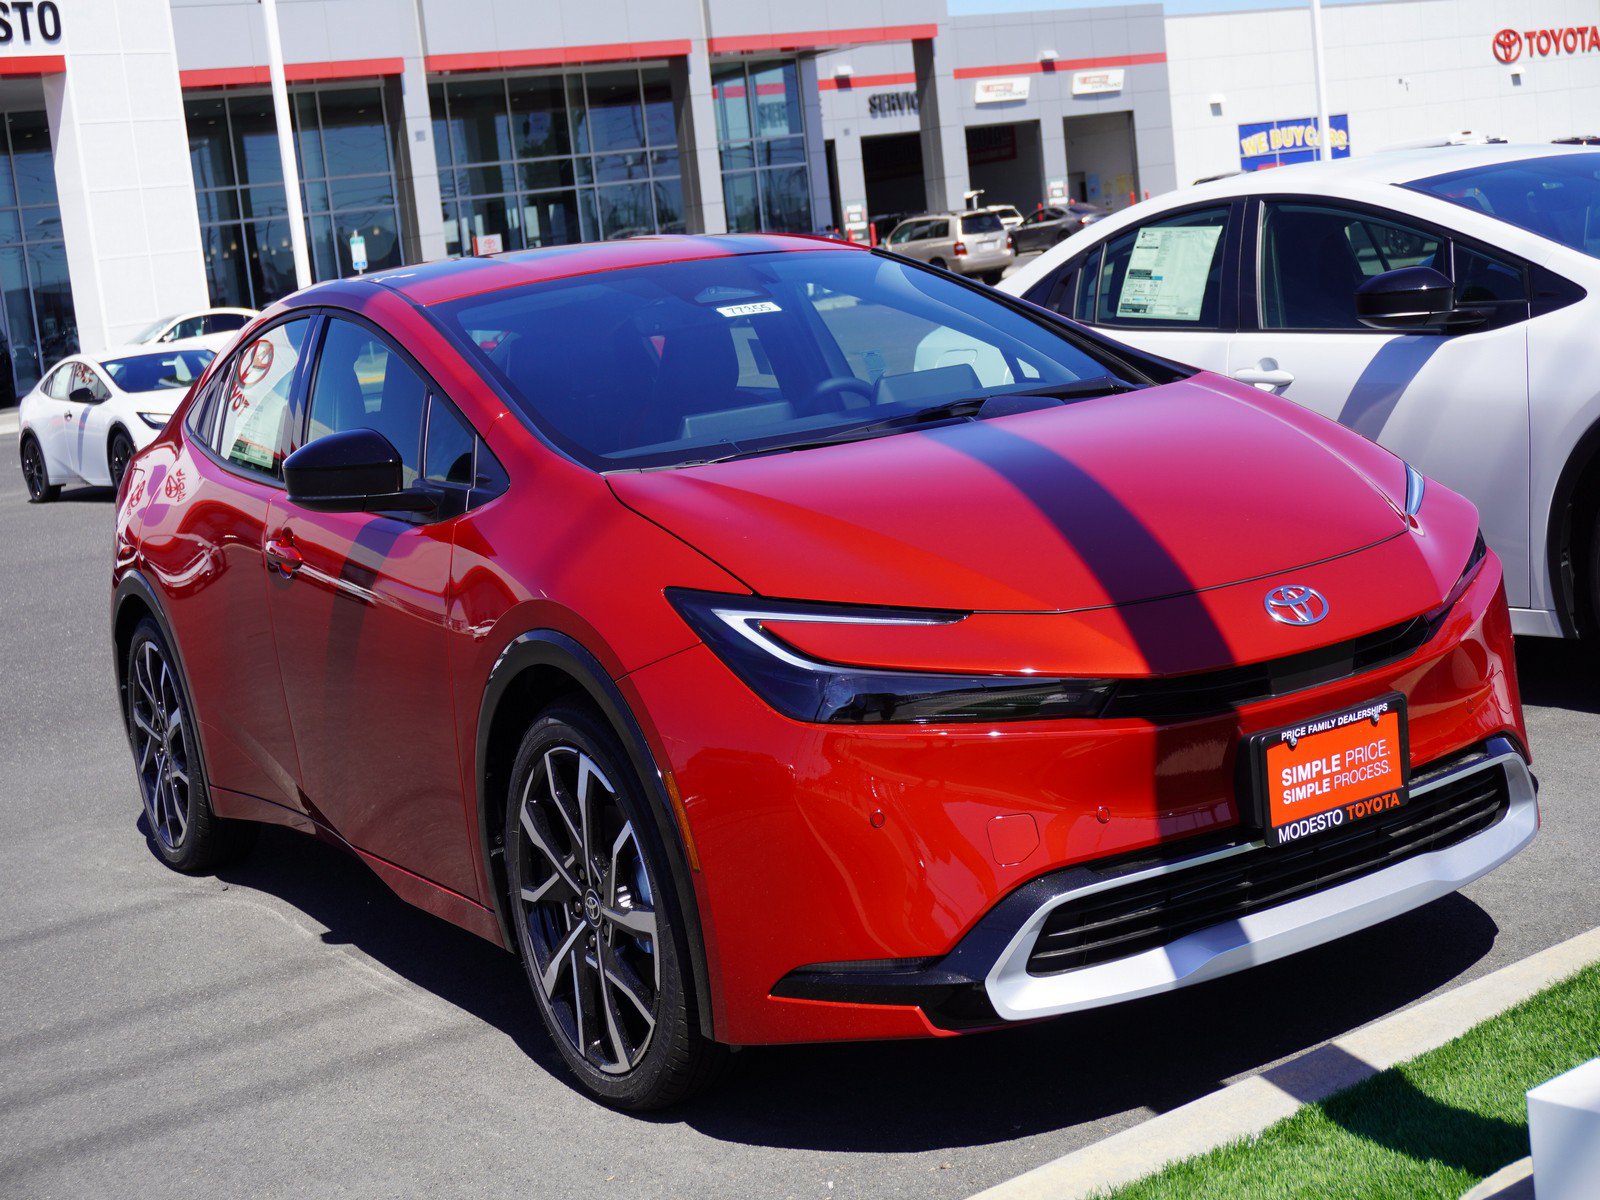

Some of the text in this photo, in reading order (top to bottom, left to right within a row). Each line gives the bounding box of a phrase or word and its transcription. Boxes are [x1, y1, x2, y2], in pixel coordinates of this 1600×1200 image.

[1524, 26, 1600, 58] TOYOTA
[1241, 131, 1269, 155] WE
[1269, 125, 1305, 149] BUY
[1281, 703, 1388, 742] PRICE FAMILY DEALERSHIPS
[1281, 739, 1391, 786] SIMPLE PRICE.
[1283, 760, 1391, 805] SIMPLE PROCESS.
[1278, 792, 1400, 844] MODESTO TOYOTA
